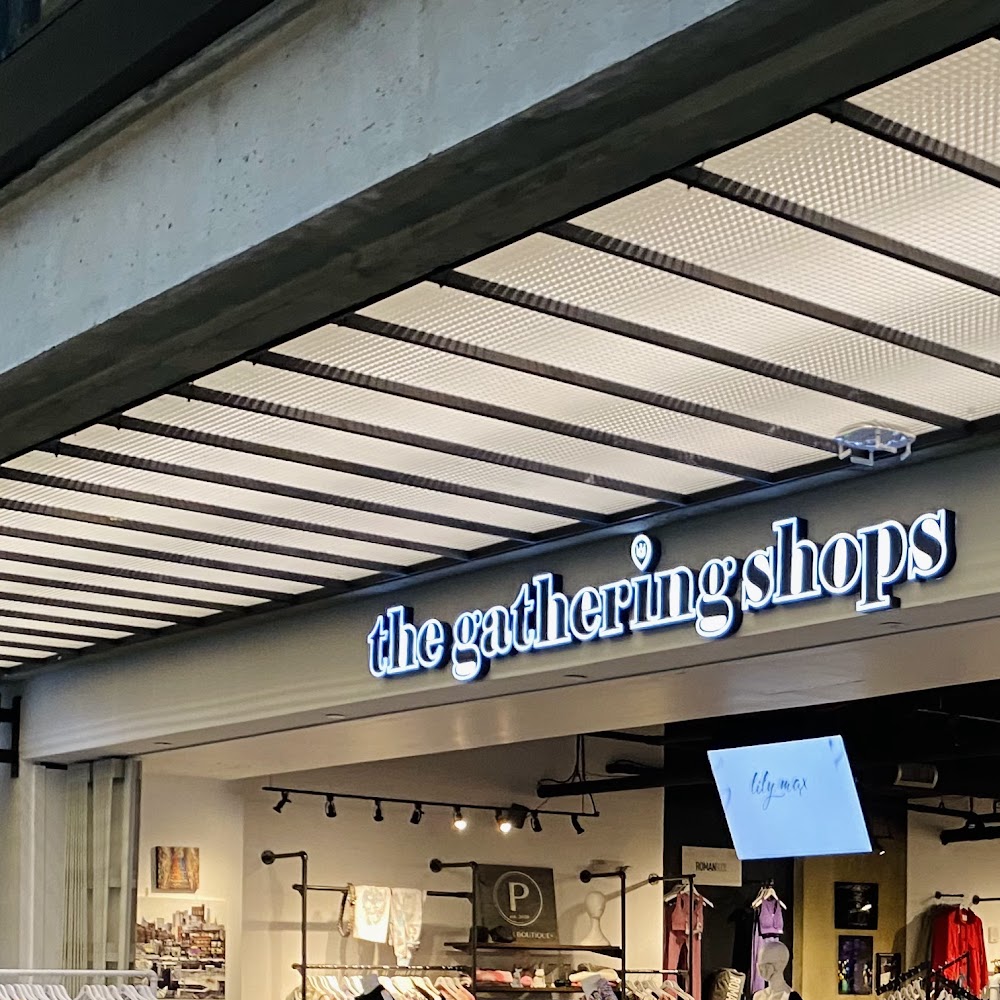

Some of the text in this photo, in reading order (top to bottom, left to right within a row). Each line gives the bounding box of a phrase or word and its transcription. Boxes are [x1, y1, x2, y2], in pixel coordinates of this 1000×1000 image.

[367, 508, 956, 681] the gathering shops
[750, 770, 807, 811] lily max
[508, 881, 530, 912] P
